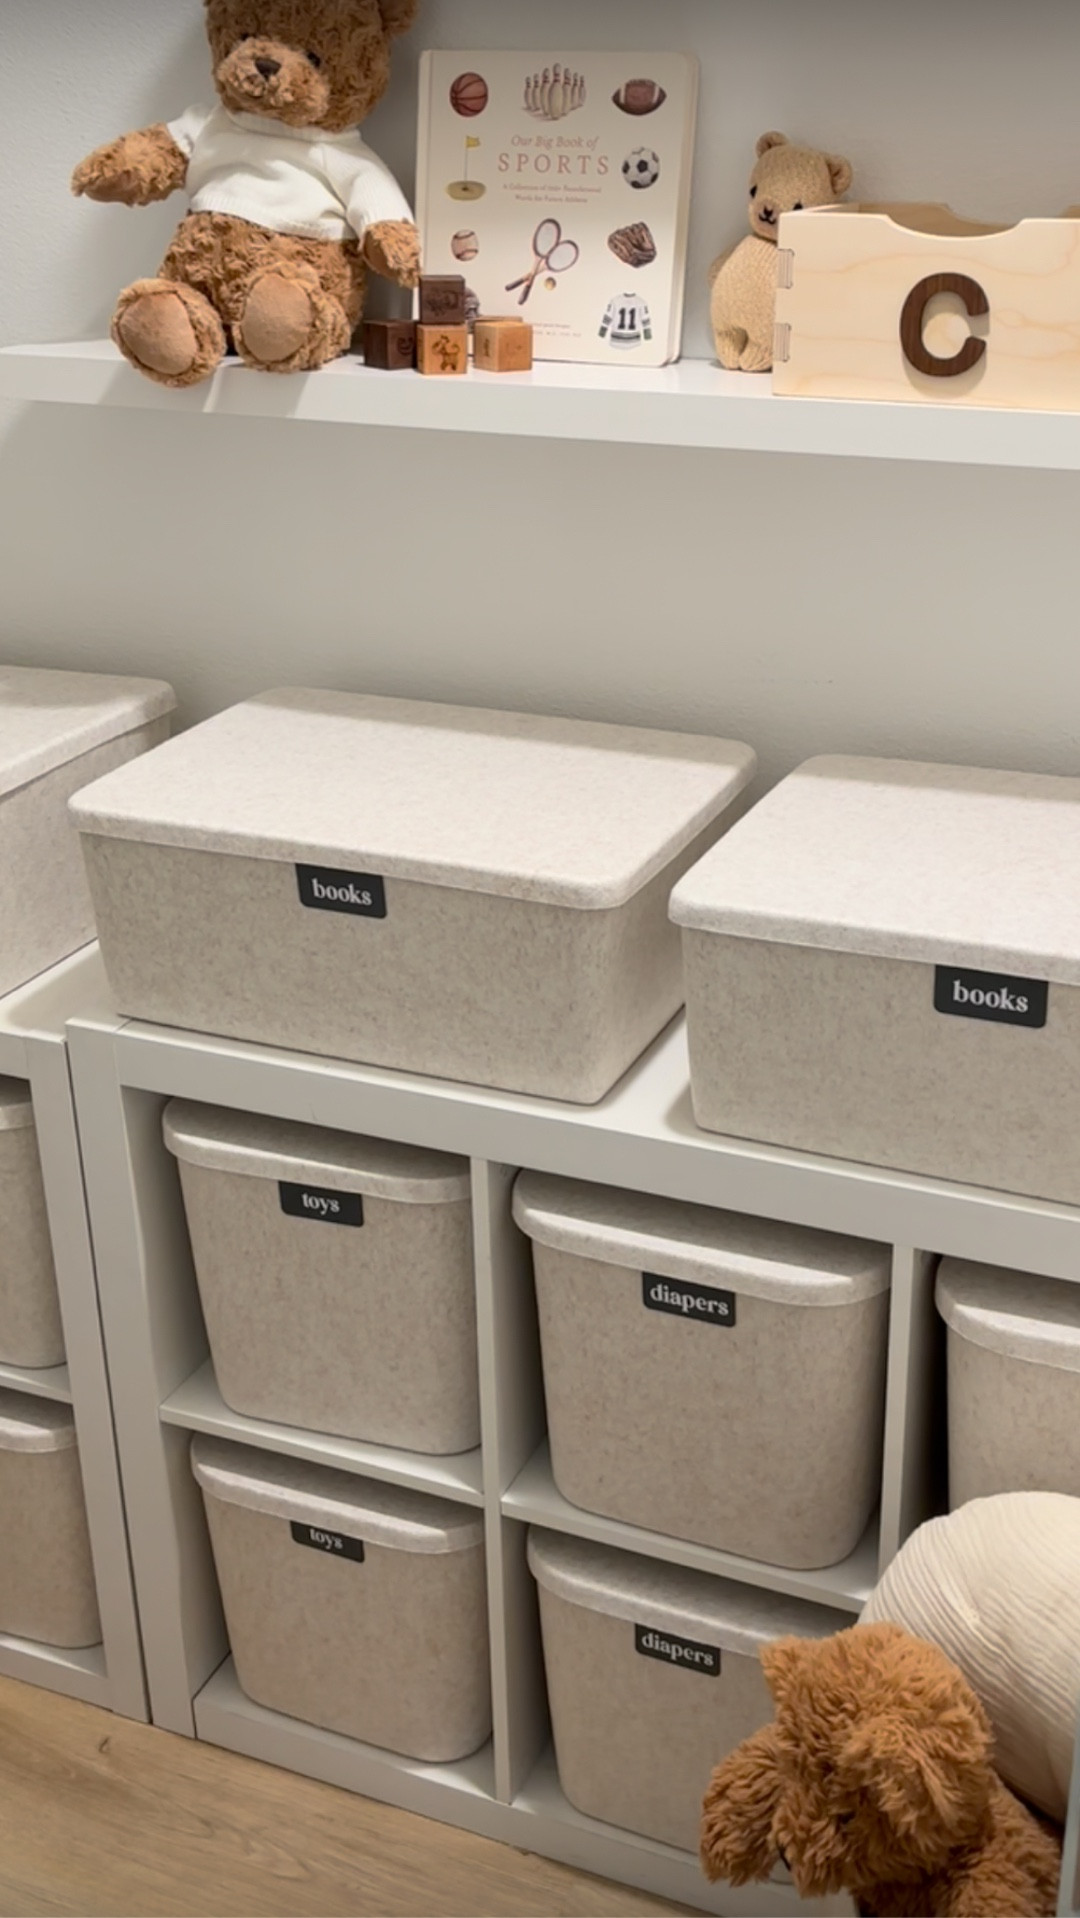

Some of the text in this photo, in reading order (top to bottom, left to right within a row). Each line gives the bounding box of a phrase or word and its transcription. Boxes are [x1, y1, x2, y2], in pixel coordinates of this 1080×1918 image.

[511, 134, 600, 151] Our Big Book of
[498, 152, 609, 176] SPORTS
[617, 307, 636, 330] 11
[899, 272, 990, 377] C
[312, 878, 373, 906] books
[953, 979, 1029, 1013] books
[301, 1192, 341, 1216] toys
[649, 1283, 729, 1316] diapers
[309, 1528, 344, 1550] toys
[641, 1632, 715, 1667] diapers
